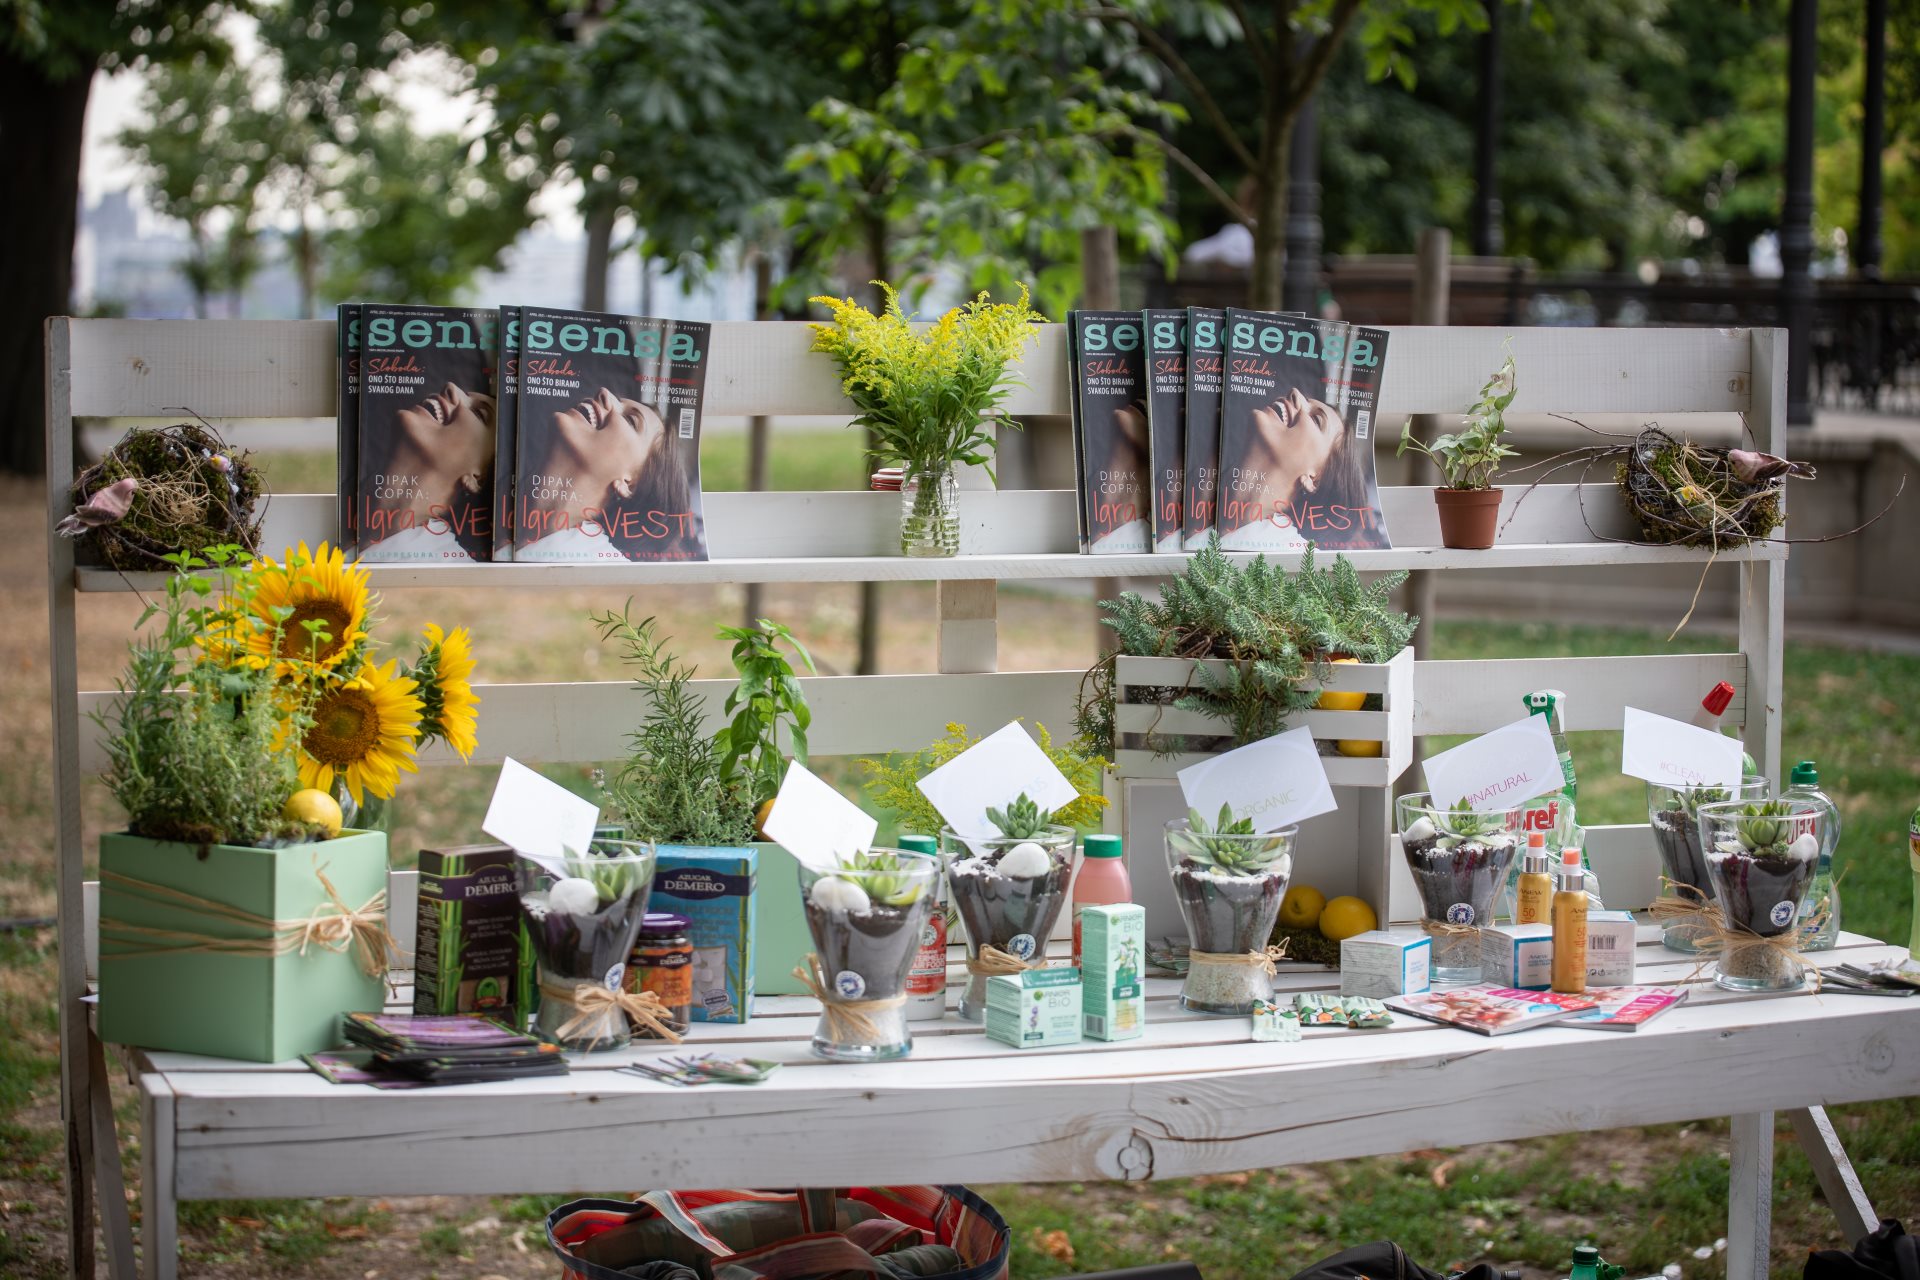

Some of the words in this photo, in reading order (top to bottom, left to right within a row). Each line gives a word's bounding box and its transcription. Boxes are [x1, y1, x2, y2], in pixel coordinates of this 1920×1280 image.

[368, 318, 500, 350] sens
[528, 320, 701, 362] sensa
[1232, 322, 1378, 367] sensa
[368, 376, 382, 384] ONO
[384, 374, 396, 384] ŠTO
[398, 376, 425, 385] BIRAMO
[528, 376, 540, 384] ONO
[542, 376, 554, 386] ŠTO
[555, 380, 580, 388] BIRAMO
[1101, 376, 1111, 385] ŠTO
[1112, 378, 1134, 386] BIRAMO
[1156, 376, 1167, 384] ONO
[1168, 375, 1178, 384] ŠTO
[1206, 374, 1216, 382] ŠTO
[1231, 375, 1242, 383] ONO
[1244, 375, 1253, 385] ŠTO
[1254, 378, 1275, 388] BIRAMO
[368, 386, 394, 394] SVAKOG
[395, 386, 414, 394] DANA
[527, 386, 551, 396] SVAKOG
[552, 388, 569, 397] DANA
[668, 386, 698, 396] POSTAVITE
[1088, 387, 1110, 395] SVAKOG
[1111, 387, 1126, 395] DANA
[1194, 384, 1214, 392] SVAKOG
[1231, 386, 1251, 394] SVAKOG
[1252, 388, 1266, 396] DANA
[1348, 389, 1373, 400] POSTAVITE
[672, 397, 696, 405] GRANICE
[1351, 399, 1372, 408] GRANICE
[1100, 471, 1136, 481] DIPAK
[1199, 468, 1217, 478] DIP
[1233, 468, 1267, 480] DIPAK
[375, 474, 418, 486] DIPAK
[532, 474, 573, 488] DIPAK
[1232, 479, 1274, 495] ČOPRA:
[374, 486, 430, 500] ČOPRA:
[1094, 490, 1136, 536] Igra
[1191, 486, 1215, 533] Igr
[1223, 486, 1263, 532] Igra
[1267, 499, 1375, 530] SVESTI
[365, 495, 416, 544] Igra
[422, 502, 490, 536] SVE
[522, 494, 570, 544] Igra
[576, 506, 695, 539] SVESTI
[1468, 772, 1532, 806] #NATURAL
[464, 882, 522, 897] DEMERO
[664, 880, 726, 892] DEMERO
[1523, 908, 1535, 917] 50
[1124, 921, 1143, 932] BIO
[1048, 997, 1071, 1008] BIO
